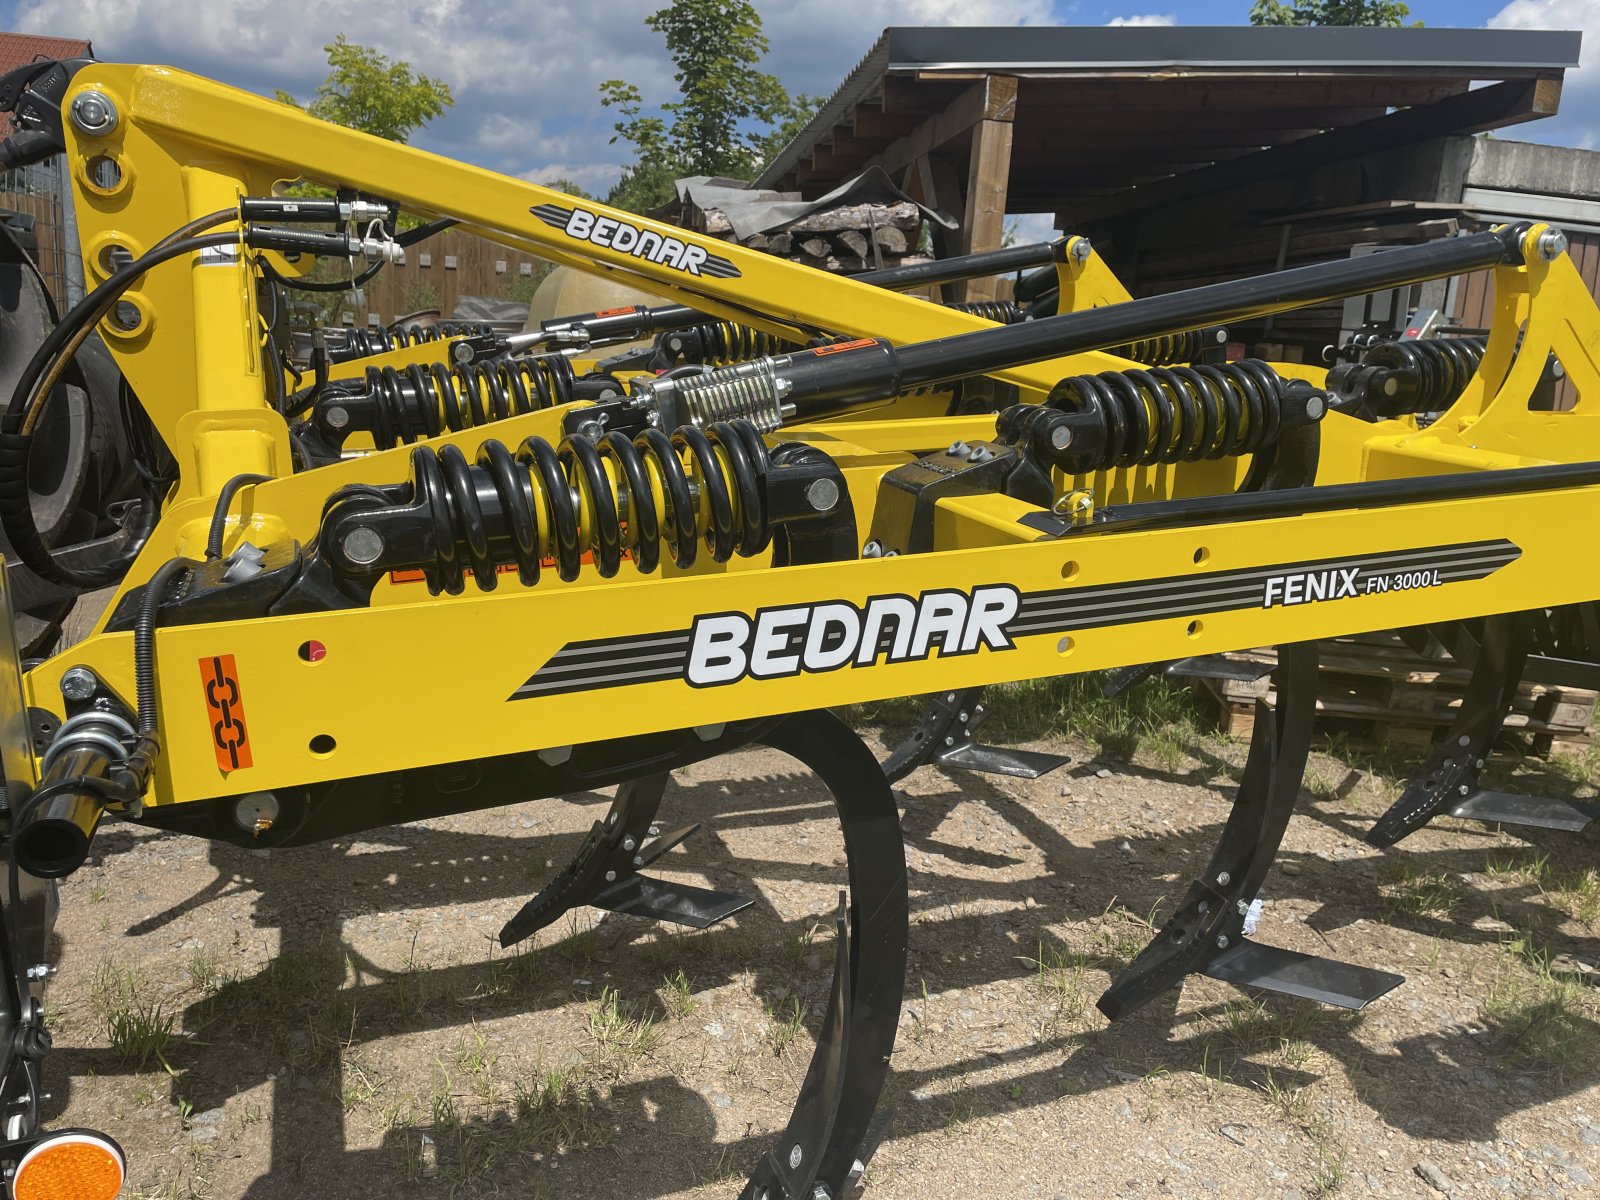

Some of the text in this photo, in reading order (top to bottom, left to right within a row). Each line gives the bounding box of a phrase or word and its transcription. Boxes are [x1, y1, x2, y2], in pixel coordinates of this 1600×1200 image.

[565, 207, 708, 276] BEDNAR
[1264, 567, 1360, 607] FENIX
[1366, 576, 1389, 594] FN
[687, 586, 1019, 685] BEDNAR
